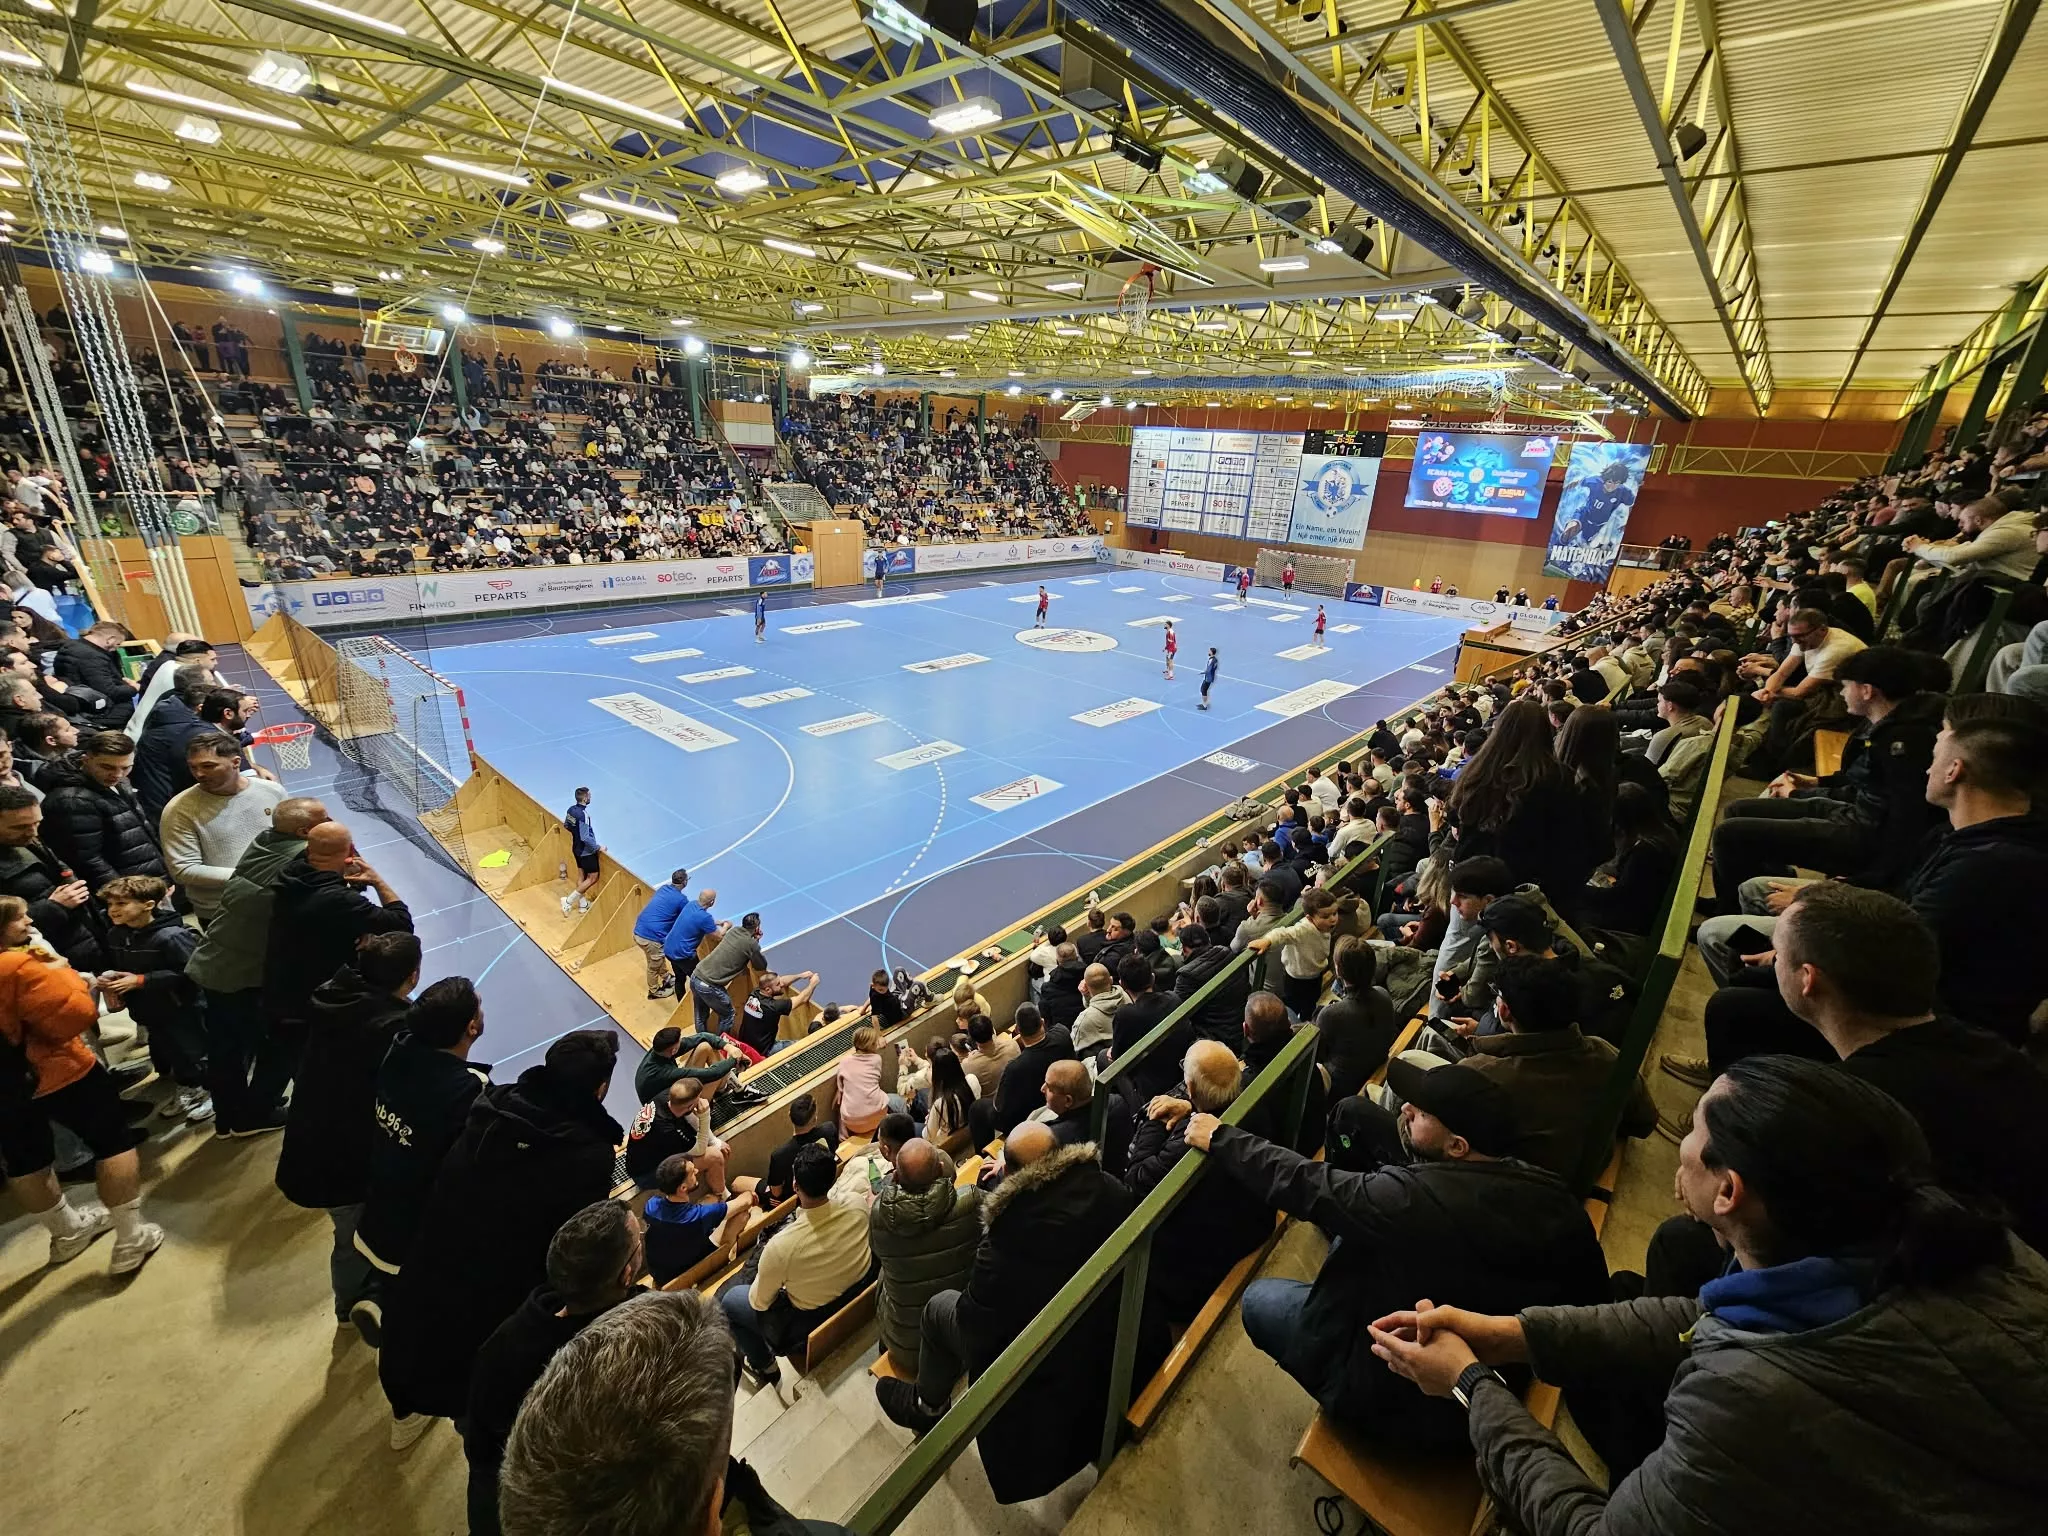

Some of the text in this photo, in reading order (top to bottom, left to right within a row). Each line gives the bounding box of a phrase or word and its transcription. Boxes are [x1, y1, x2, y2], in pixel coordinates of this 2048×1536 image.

[1593, 499, 1604, 509] 10
[1550, 545, 1613, 567] MATCHDAY
[1176, 562, 1194, 570] SIRA
[657, 570, 697, 583] sotec.
[707, 575, 743, 584] PEPARTS
[474, 591, 527, 603] PEPARTS
[409, 600, 456, 612] FINWIWO
[1520, 612, 1547, 621] GLOBAL
[387, 1112, 401, 1131] 96
